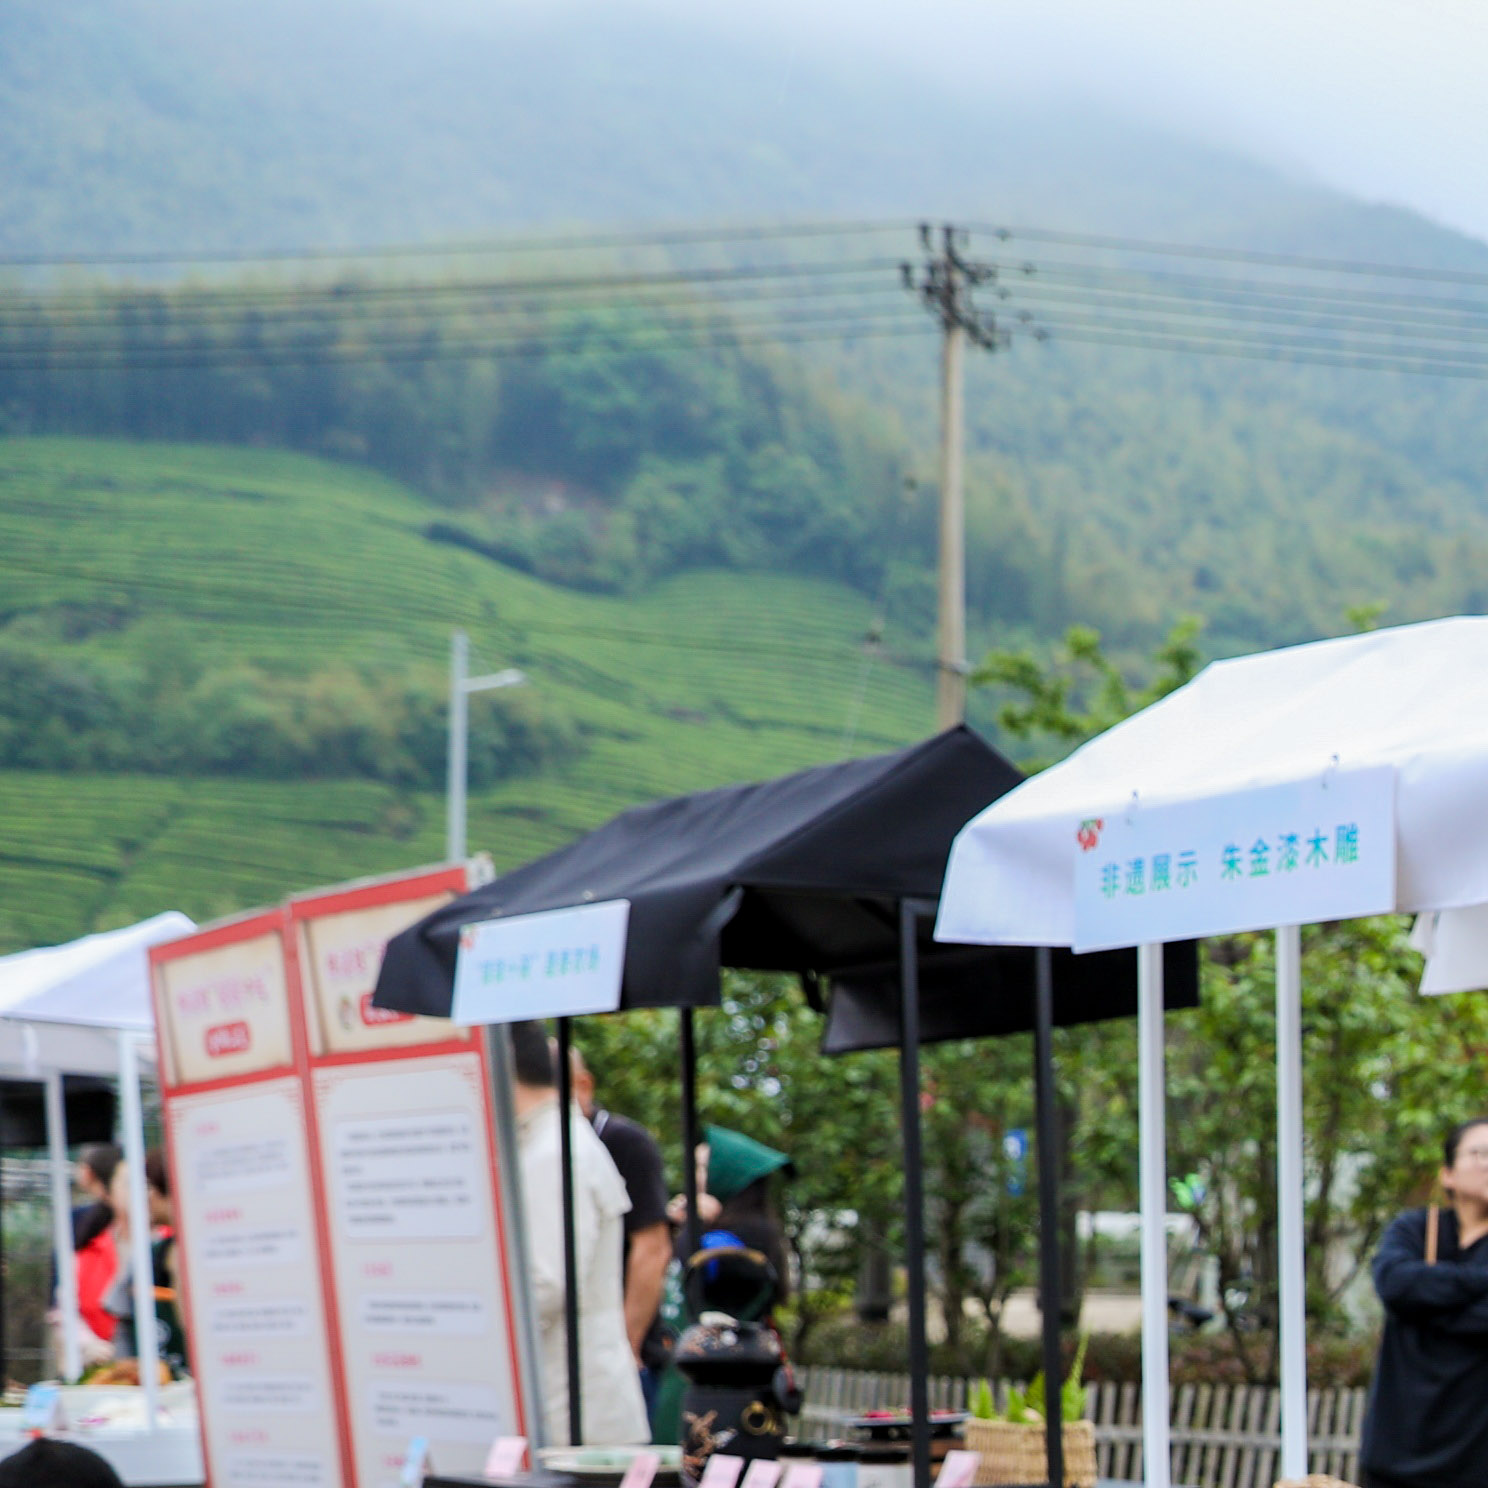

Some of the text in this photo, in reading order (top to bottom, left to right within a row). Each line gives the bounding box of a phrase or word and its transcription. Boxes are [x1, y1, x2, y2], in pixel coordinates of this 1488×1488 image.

[1100, 823, 1359, 898] 非遗展示 朱金漆木雕
